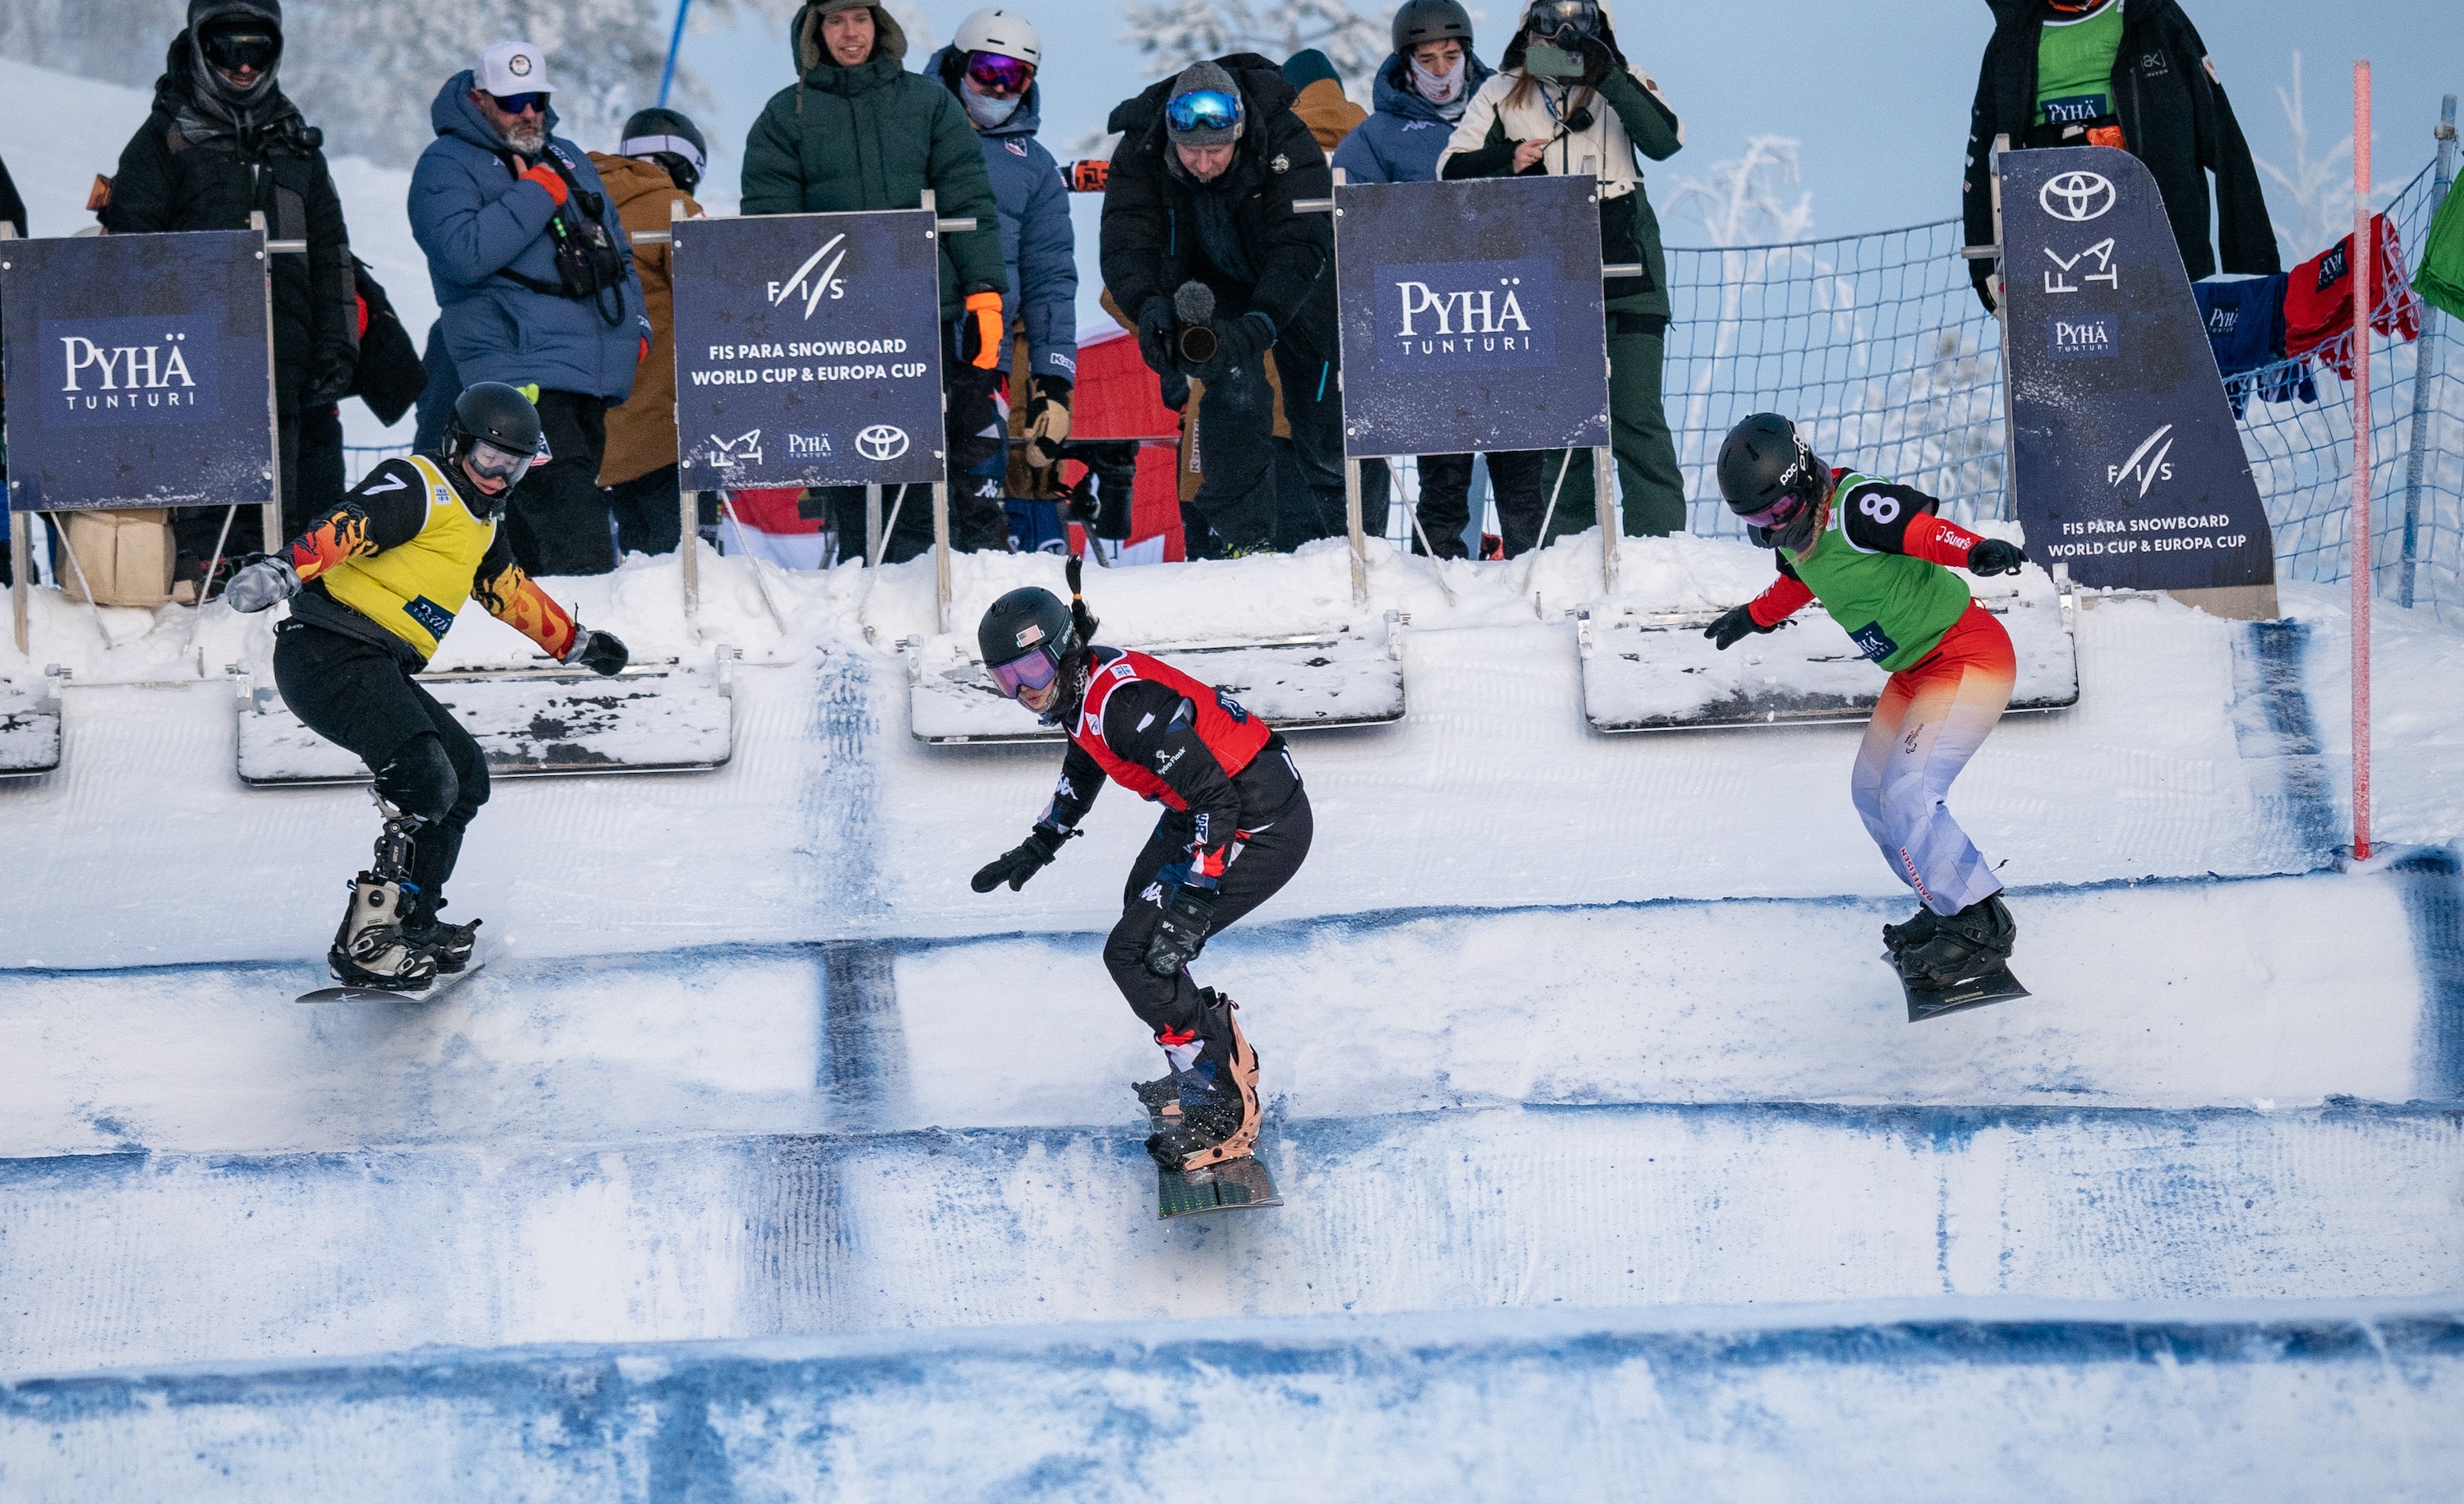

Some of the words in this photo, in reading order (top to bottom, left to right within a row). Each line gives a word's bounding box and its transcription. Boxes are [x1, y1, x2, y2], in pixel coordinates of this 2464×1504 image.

[2048, 99, 2098, 122] PYHÄ
[1395, 278, 1532, 337] PYHÄ
[2055, 320, 2109, 346] PYHÄ
[709, 345, 735, 361] FIS
[738, 343, 784, 359] PARA
[788, 338, 908, 358] SNOWBOARD
[1402, 336, 1529, 356] TUNTURI
[2057, 344, 2109, 353] TUNTURI
[60, 333, 196, 392] PYHÄ
[692, 369, 758, 386] WORLD
[761, 367, 798, 384] CUP
[802, 367, 814, 382] &
[817, 364, 887, 382] EUROPA
[891, 362, 927, 378] CUP
[66, 392, 195, 410] TUNTURI
[788, 433, 832, 453] PYHÄ
[361, 472, 408, 496] 7
[1859, 493, 1901, 525] 8
[2062, 522, 2085, 536] FIS
[2087, 519, 2126, 535] PARA
[2130, 514, 2230, 531] SNOWBOARD
[2048, 542, 2104, 557] WORLD
[2108, 540, 2137, 554] CUP
[2140, 540, 2151, 553] &
[2154, 537, 2213, 552] EUROPA
[2217, 534, 2247, 549] CUP
[1156, 761, 1173, 775] Hydro
[1170, 747, 1186, 764] Flask
[1901, 848, 1933, 902] RAIFFEISEN
